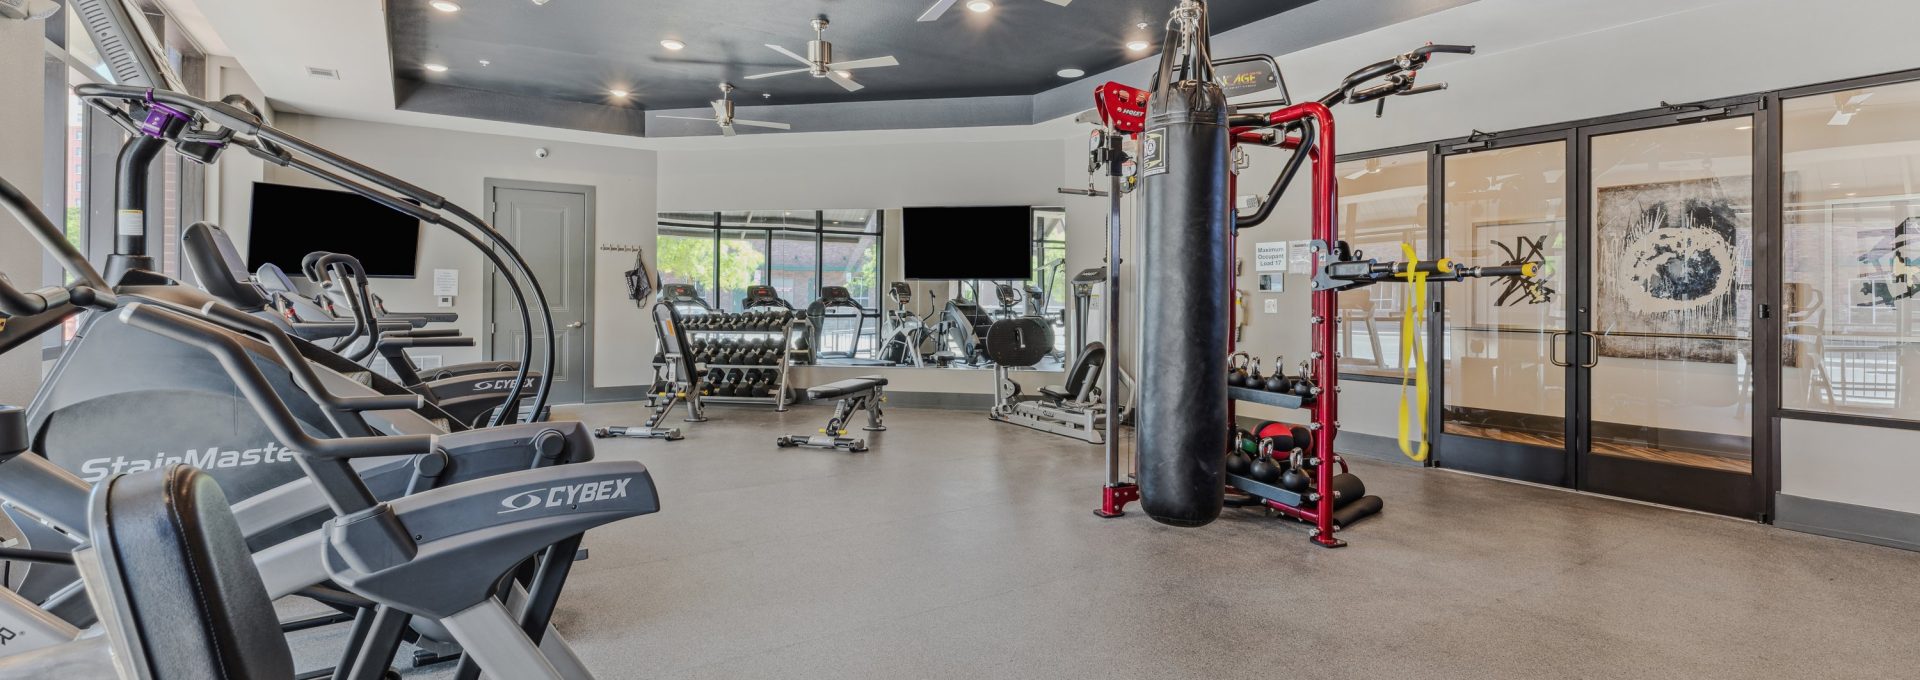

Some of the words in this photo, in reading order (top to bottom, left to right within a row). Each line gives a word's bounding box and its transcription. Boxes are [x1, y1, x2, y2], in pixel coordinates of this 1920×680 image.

[1122, 108, 1145, 118] HOIST
[81, 441, 296, 483] StairMaste
[545, 477, 632, 508] CYBEX
